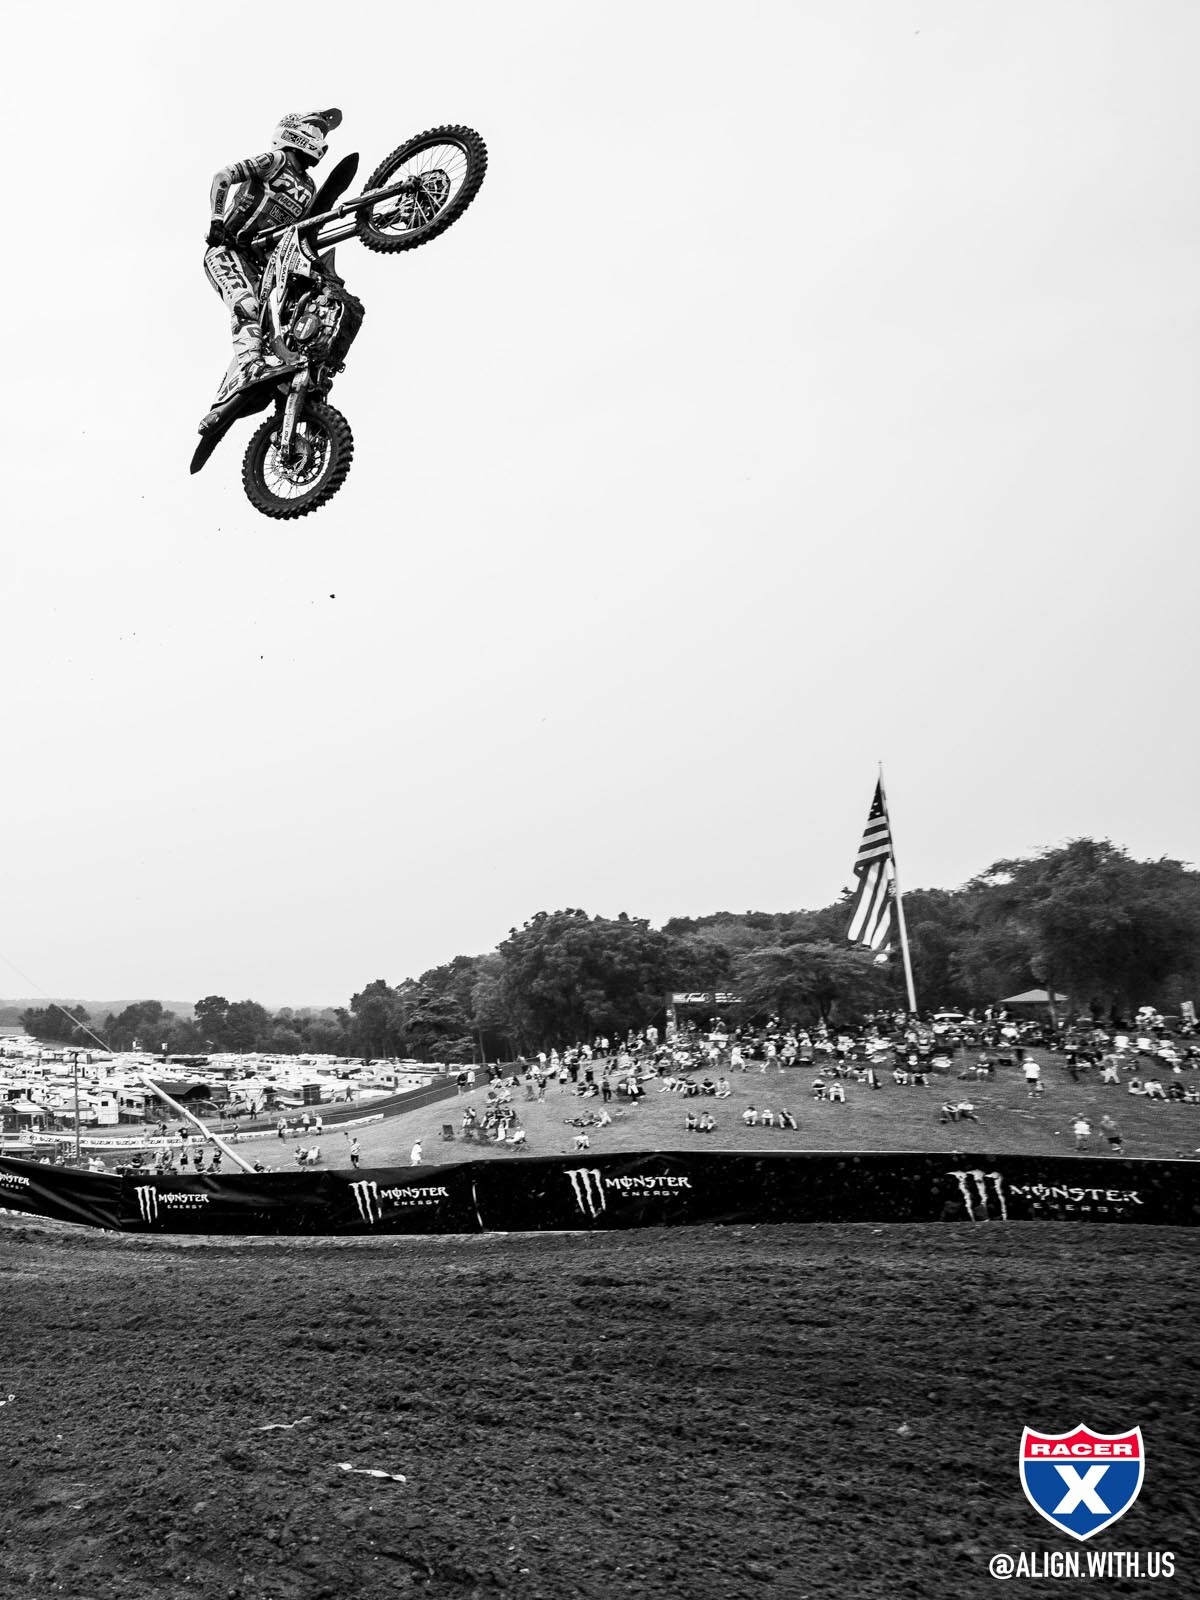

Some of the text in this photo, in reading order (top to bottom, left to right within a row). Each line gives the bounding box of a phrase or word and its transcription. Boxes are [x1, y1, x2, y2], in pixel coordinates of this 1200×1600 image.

[605, 1174, 693, 1190] MONSTER
[158, 1191, 210, 1203] MONSTER
[380, 1186, 449, 1200] MONSTER
[1009, 1183, 1145, 1204] MONSTER
